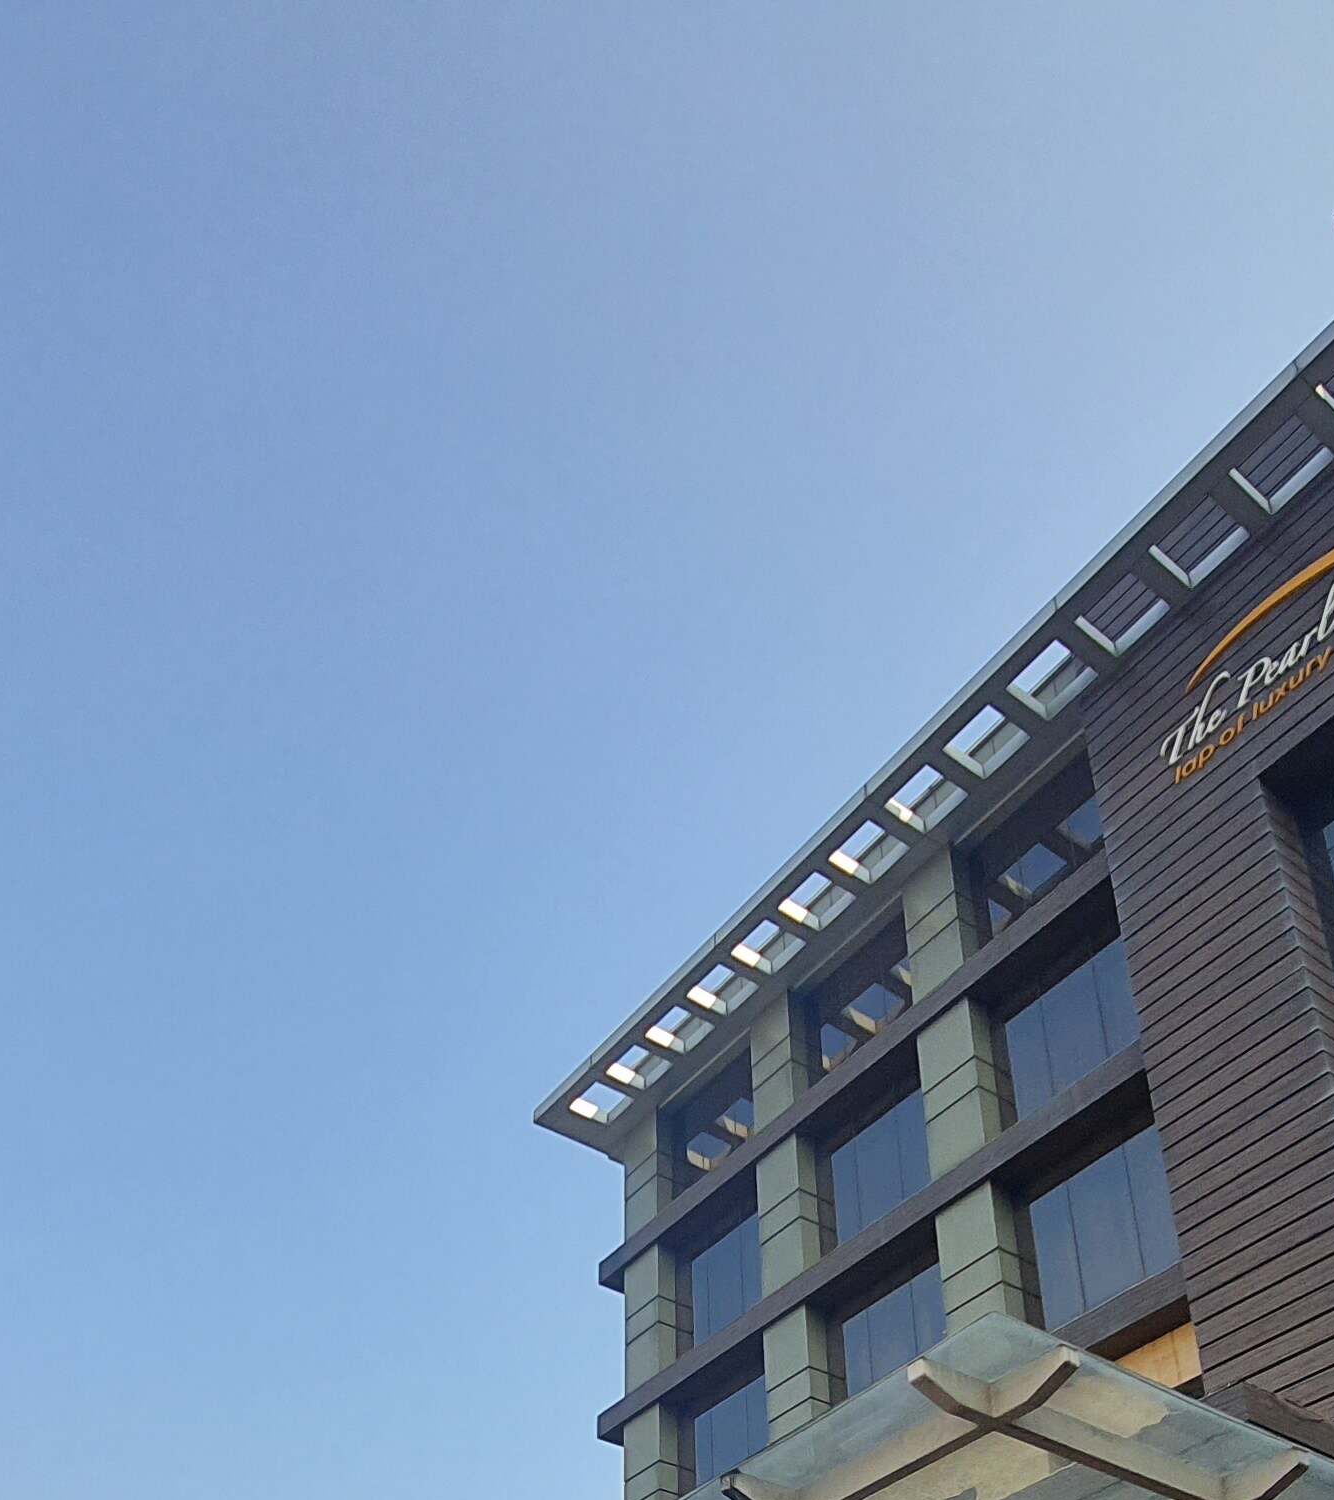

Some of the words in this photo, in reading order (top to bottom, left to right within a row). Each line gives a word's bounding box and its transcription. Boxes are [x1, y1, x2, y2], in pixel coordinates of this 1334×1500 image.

[1160, 670, 1231, 766] The
[1174, 743, 1216, 784] lap
[1219, 711, 1247, 746] of
[1252, 645, 1334, 721] luxury
